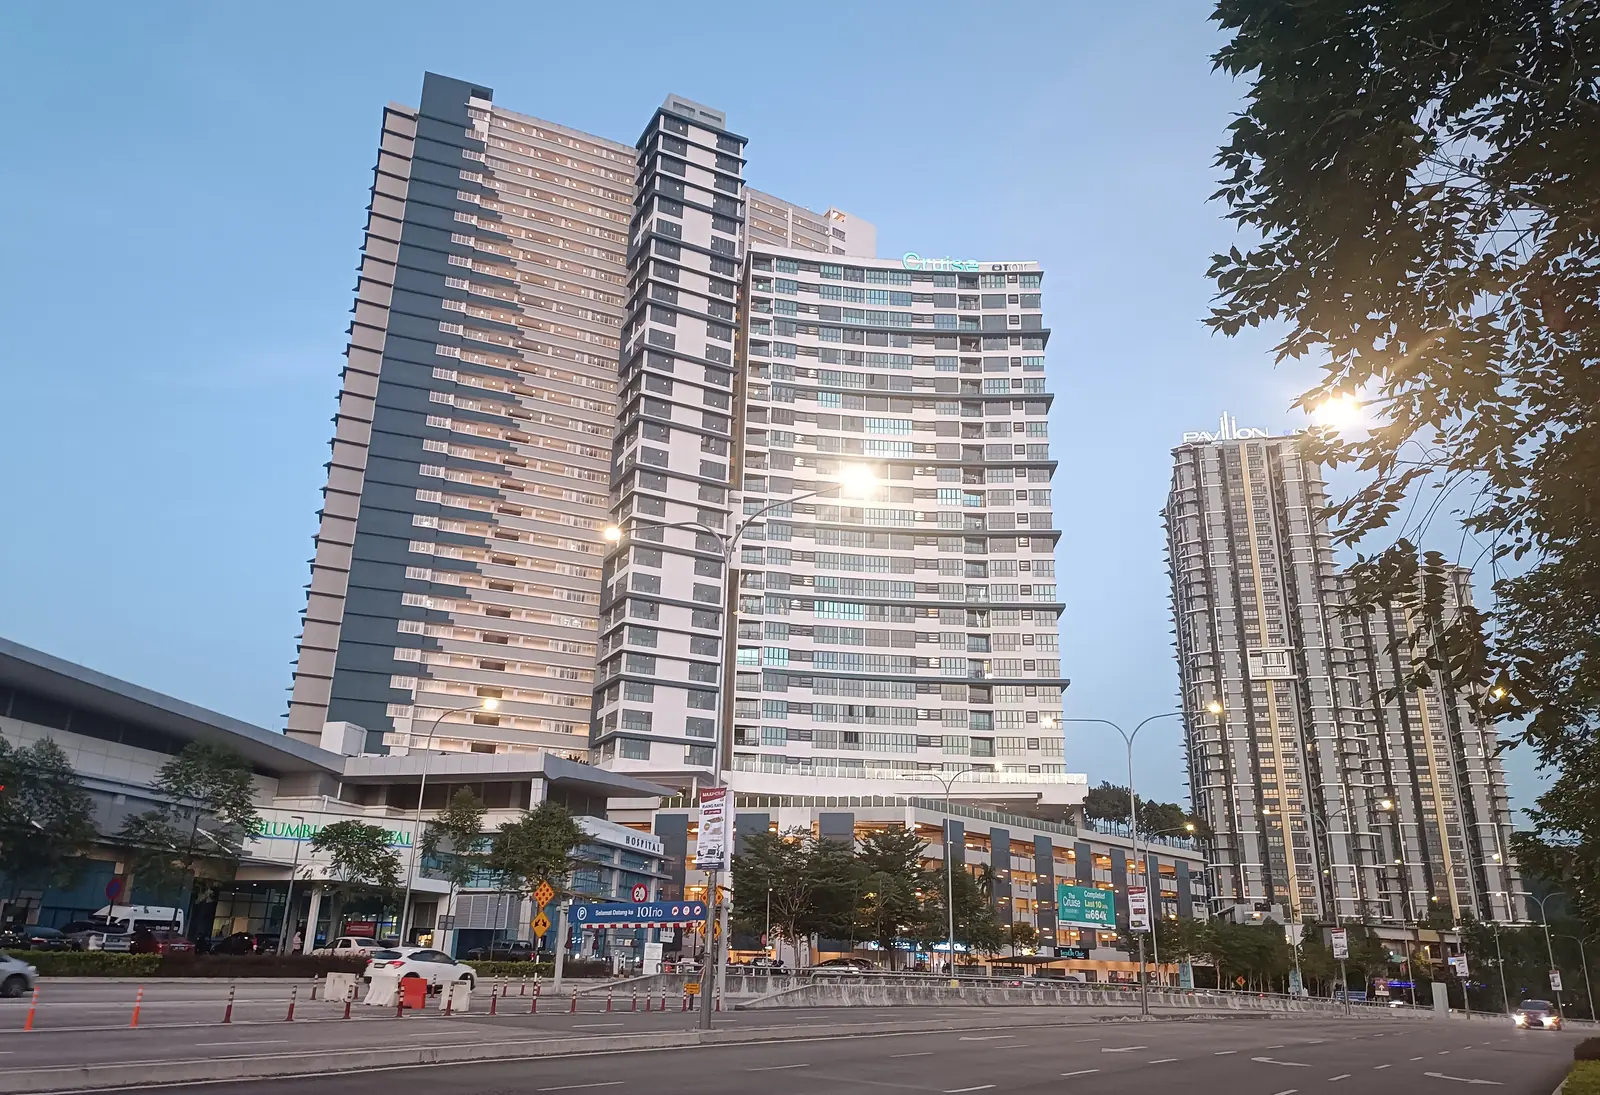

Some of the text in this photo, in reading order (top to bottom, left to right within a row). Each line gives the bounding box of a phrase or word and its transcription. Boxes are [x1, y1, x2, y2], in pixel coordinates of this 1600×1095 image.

[252, 820, 327, 839] LUMBI
[625, 835, 660, 853] HOSPITAL
[1084, 890, 1106, 899] Completed
[1063, 896, 1081, 908] Cruise
[1084, 899, 1095, 908] Last
[1095, 900, 1102, 909] 10
[612, 909, 628, 917] Datang
